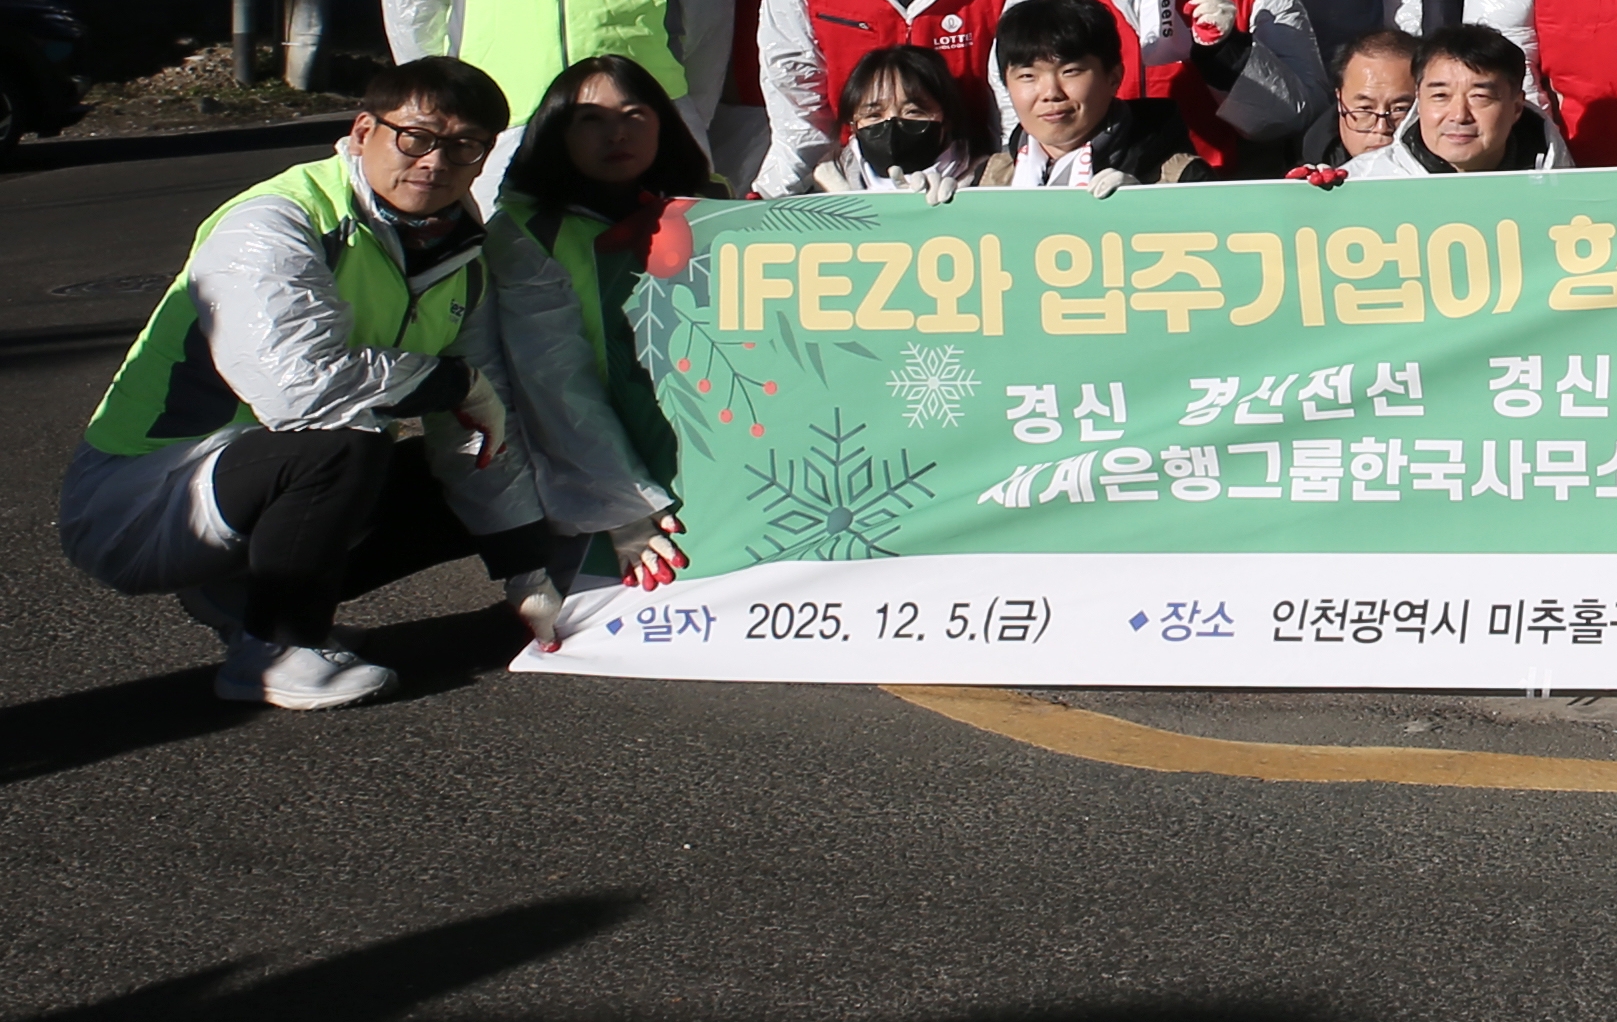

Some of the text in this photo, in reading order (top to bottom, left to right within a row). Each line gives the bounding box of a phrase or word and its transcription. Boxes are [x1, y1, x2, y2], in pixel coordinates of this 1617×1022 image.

[720, 235, 1012, 335] IFEZ와
[1036, 220, 1522, 334] 입주기업이
[1007, 383, 1126, 443] 경신
[1180, 363, 1424, 425] 경신전선
[637, 597, 1051, 643] 일자 2025. 12. 5.(금)
[1161, 601, 1234, 641] 장소
[1273, 599, 1469, 644] 인천광역시
